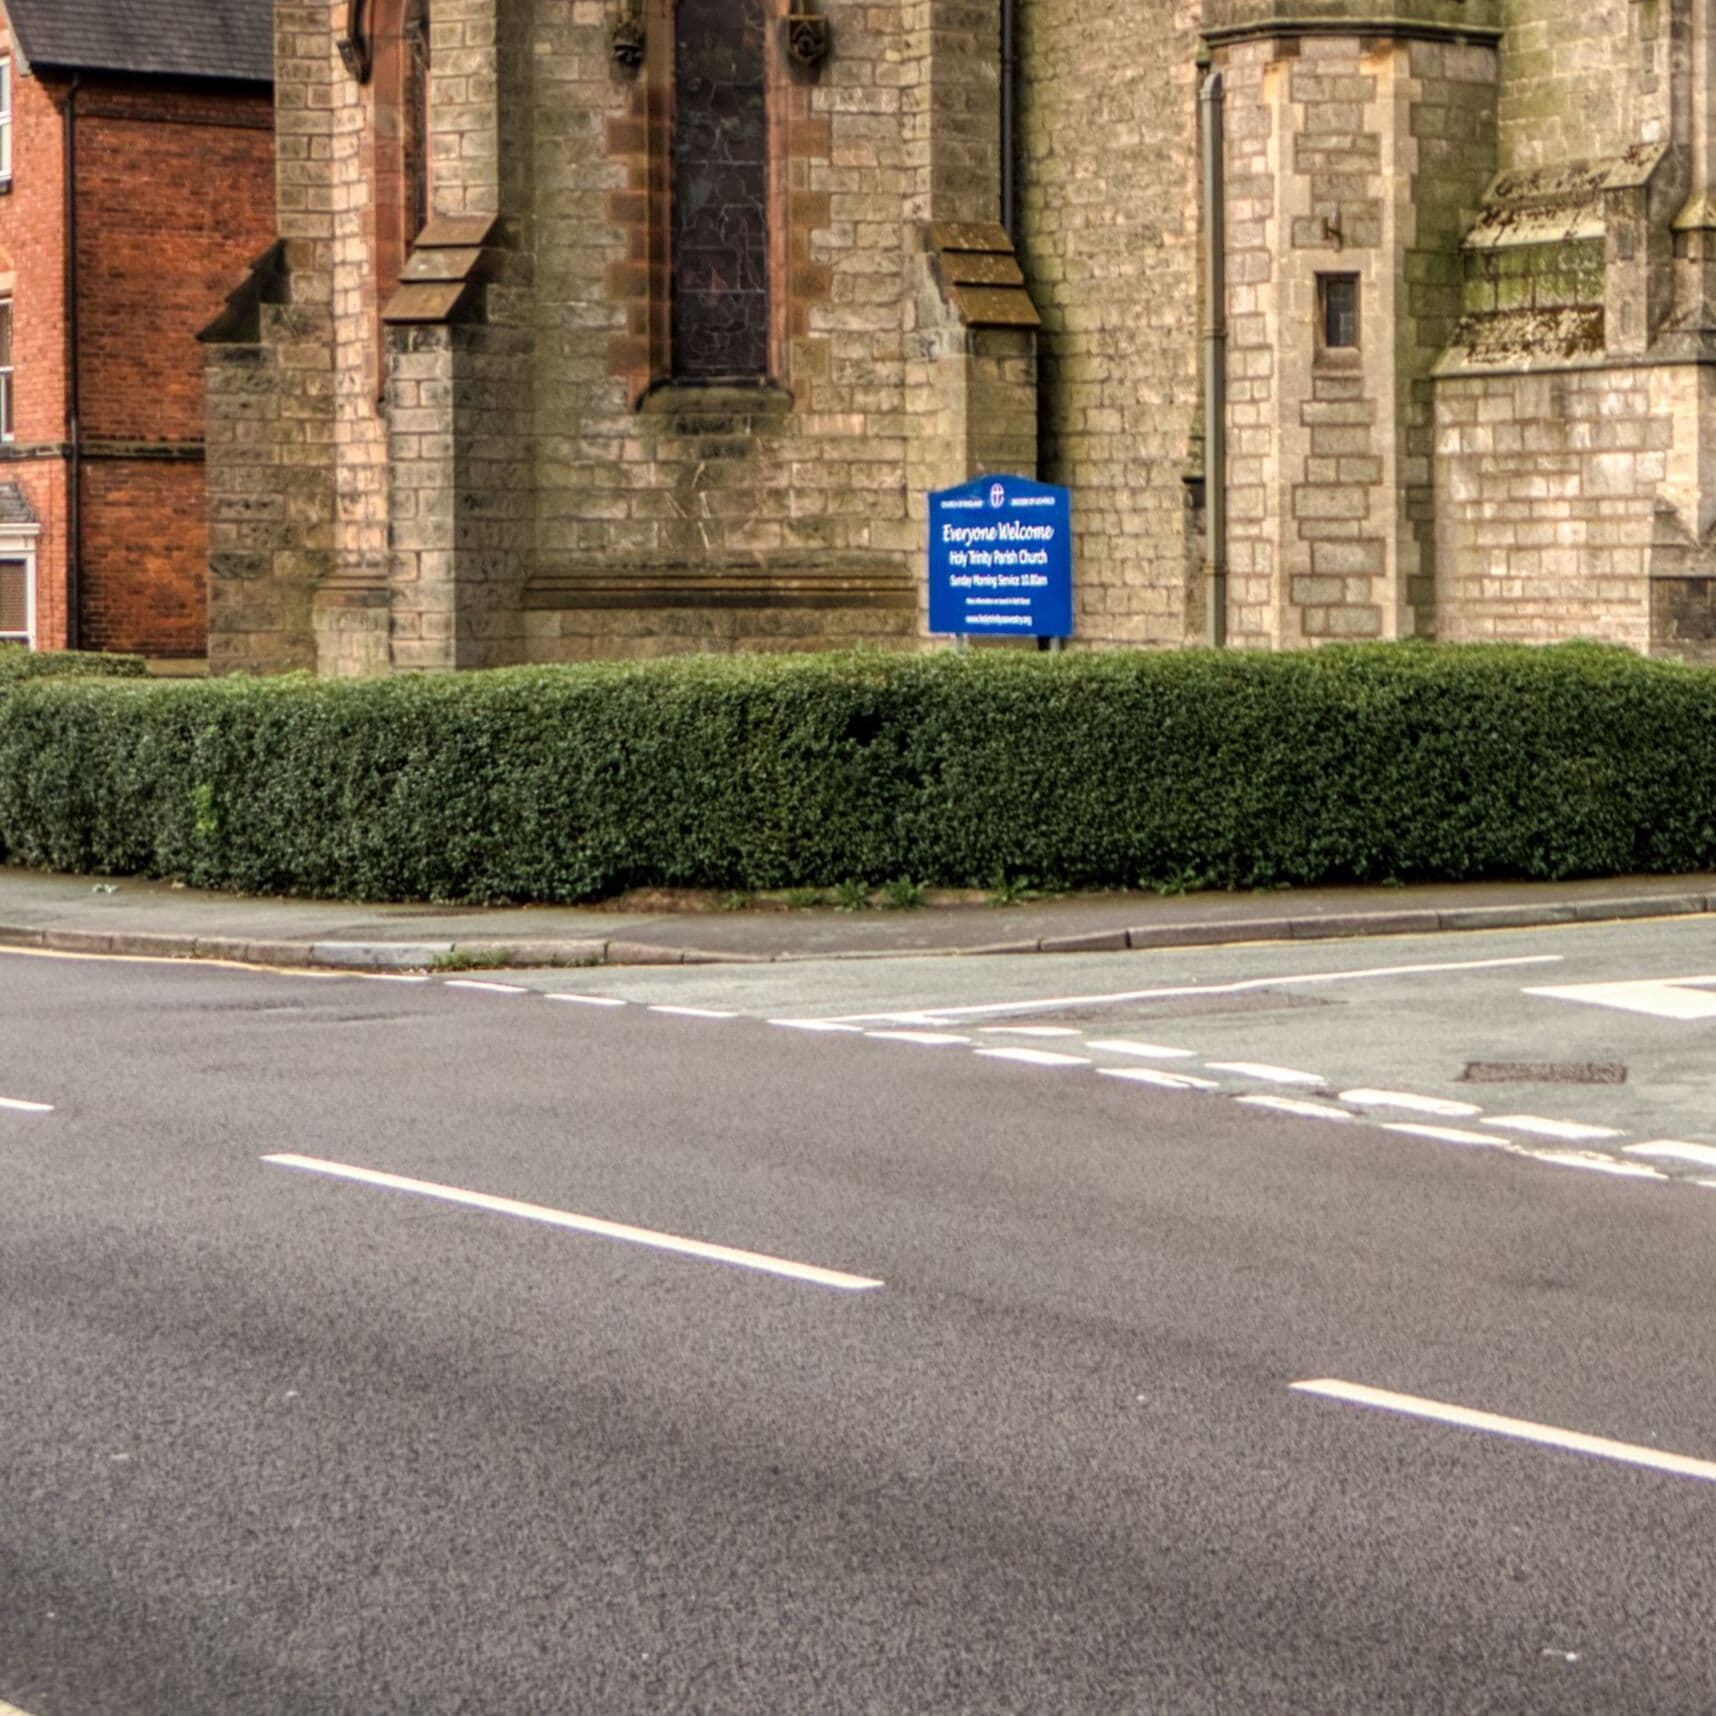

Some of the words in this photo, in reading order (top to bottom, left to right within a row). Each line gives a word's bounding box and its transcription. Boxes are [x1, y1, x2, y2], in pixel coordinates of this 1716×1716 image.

[943, 524, 997, 546] Everyone
[998, 520, 1055, 541] Welcome
[949, 550, 967, 568] Holy
[968, 550, 992, 568] Trinity
[993, 549, 1018, 565] Parish
[1019, 548, 1048, 565] Church
